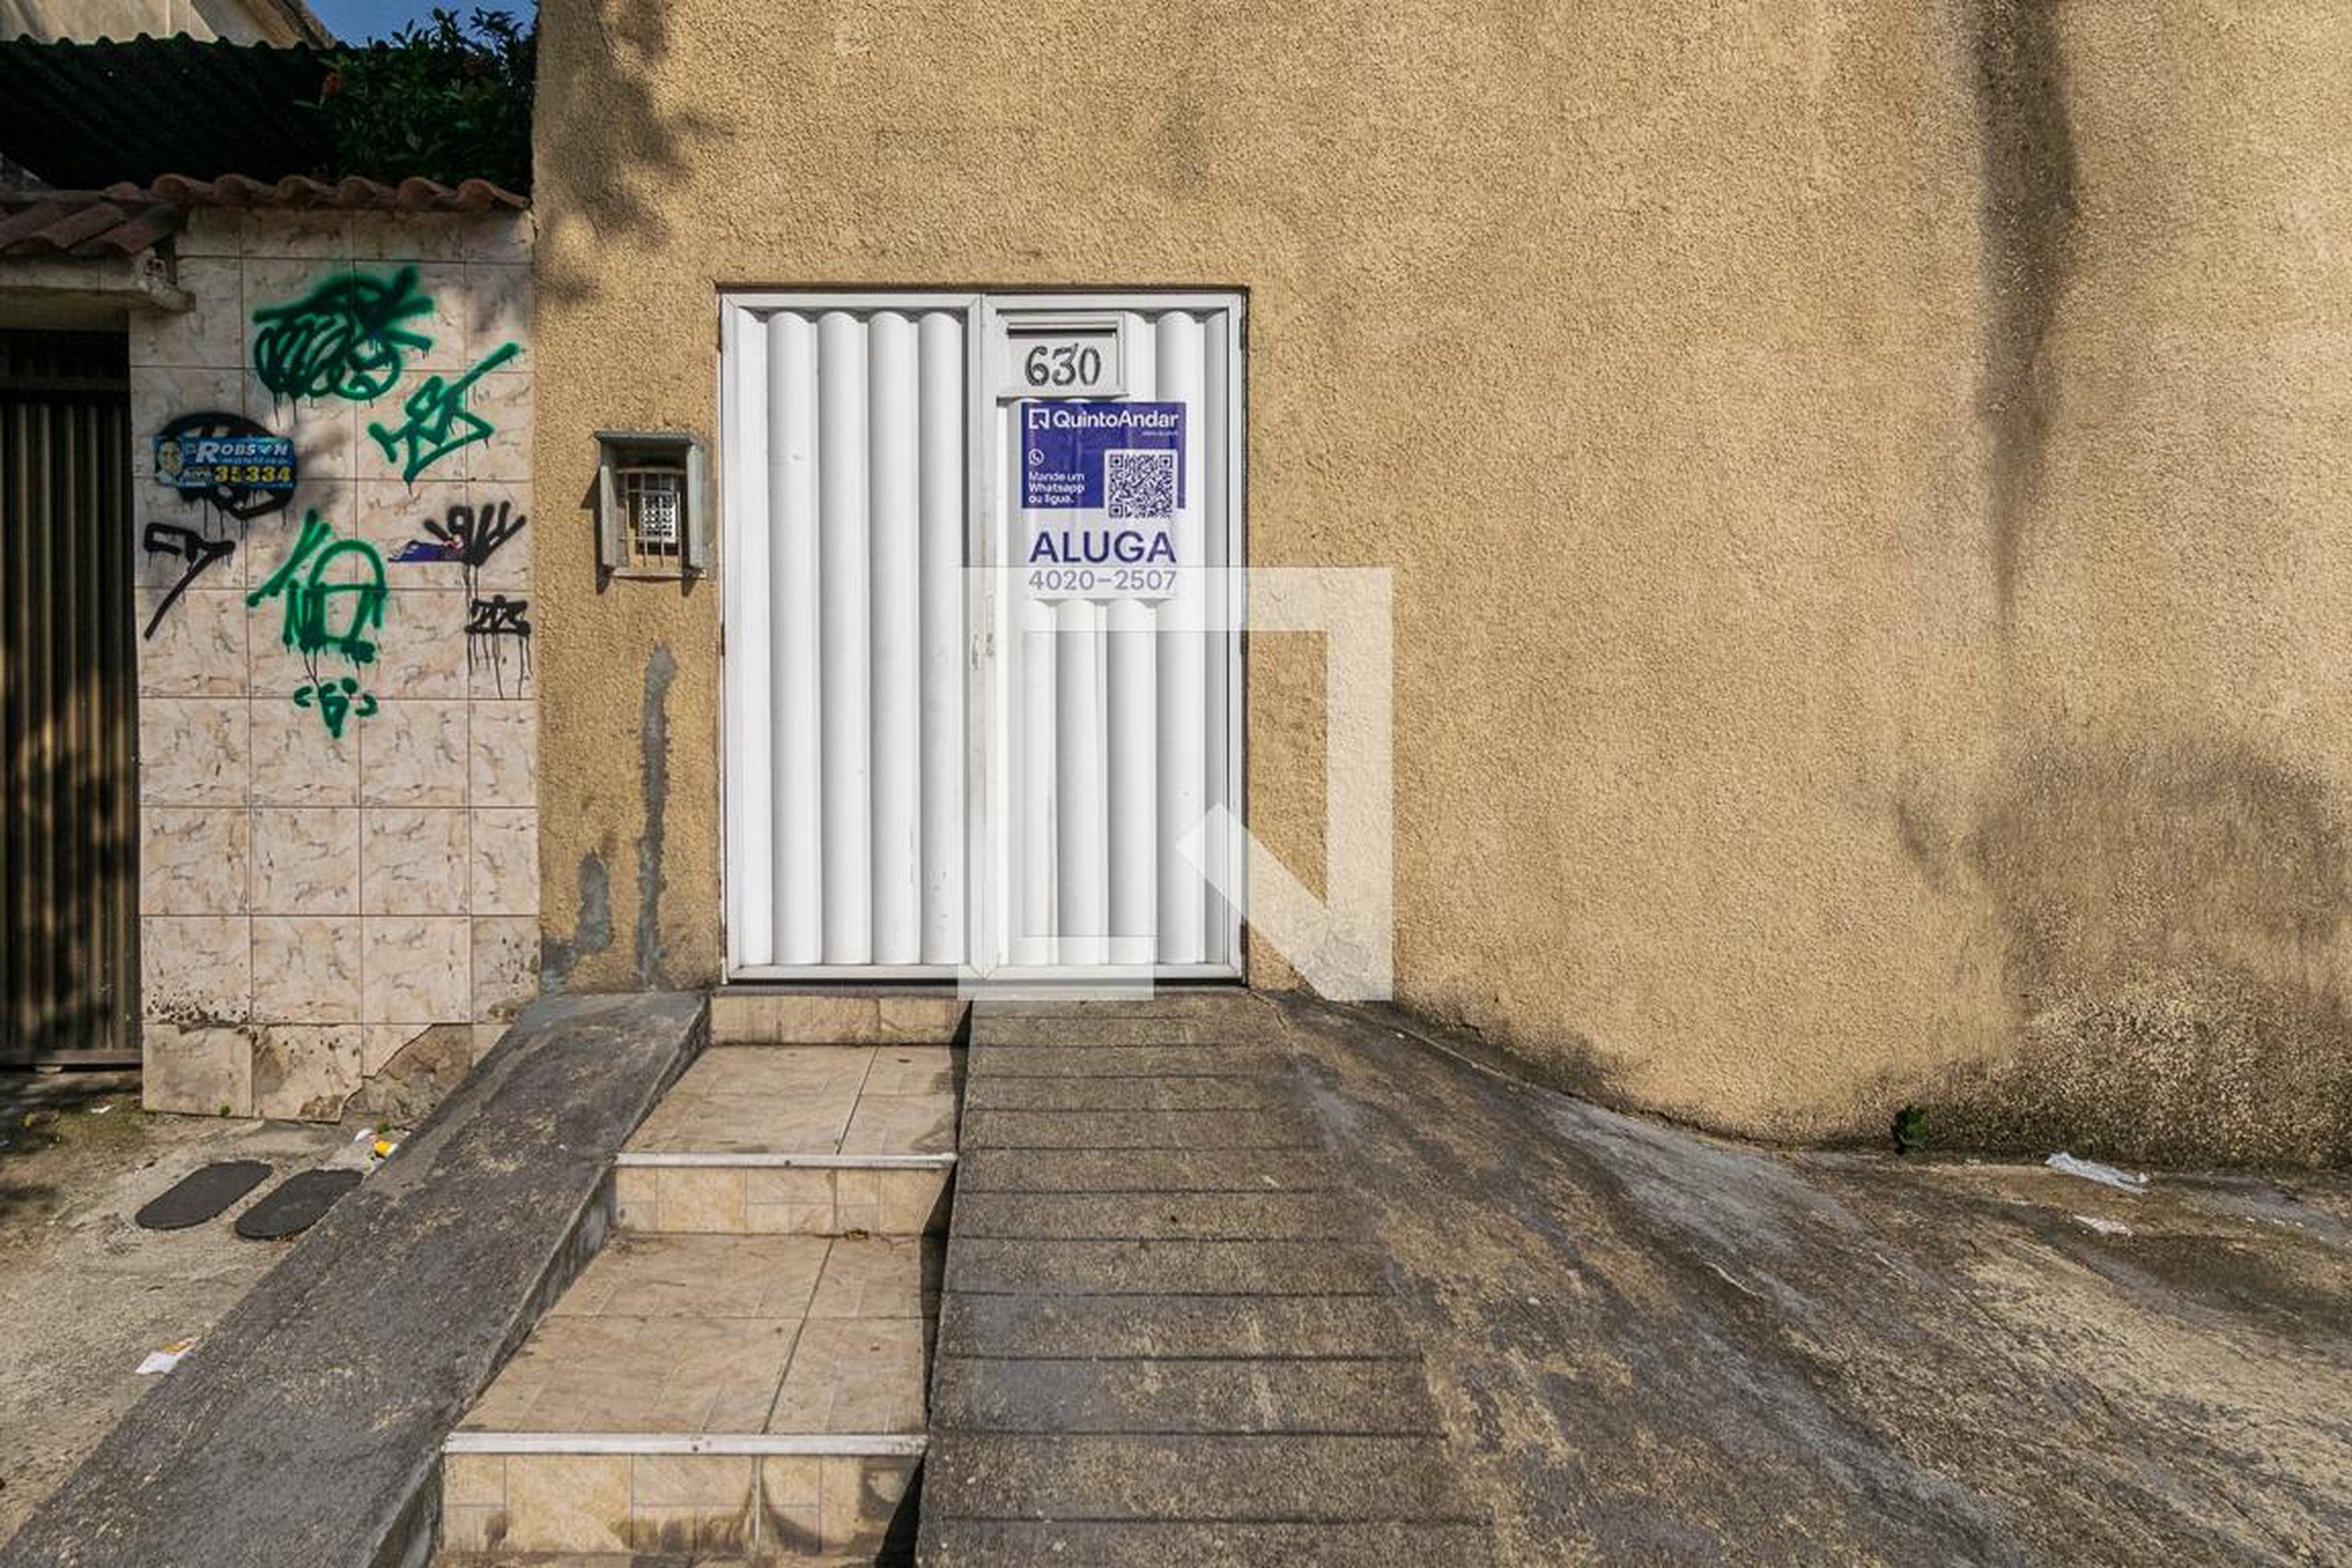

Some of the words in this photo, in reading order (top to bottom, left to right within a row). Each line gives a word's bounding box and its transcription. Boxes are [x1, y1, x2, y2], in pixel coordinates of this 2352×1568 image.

[1025, 342, 1102, 386] 630
[1052, 409, 1179, 428] QuintoAndar
[214, 465, 291, 483] 35334
[1028, 471, 1066, 481] Mande
[1068, 473, 1085, 481] um
[1029, 530, 1177, 563] ALUGA
[1029, 570, 1177, 590] 4020-2507
